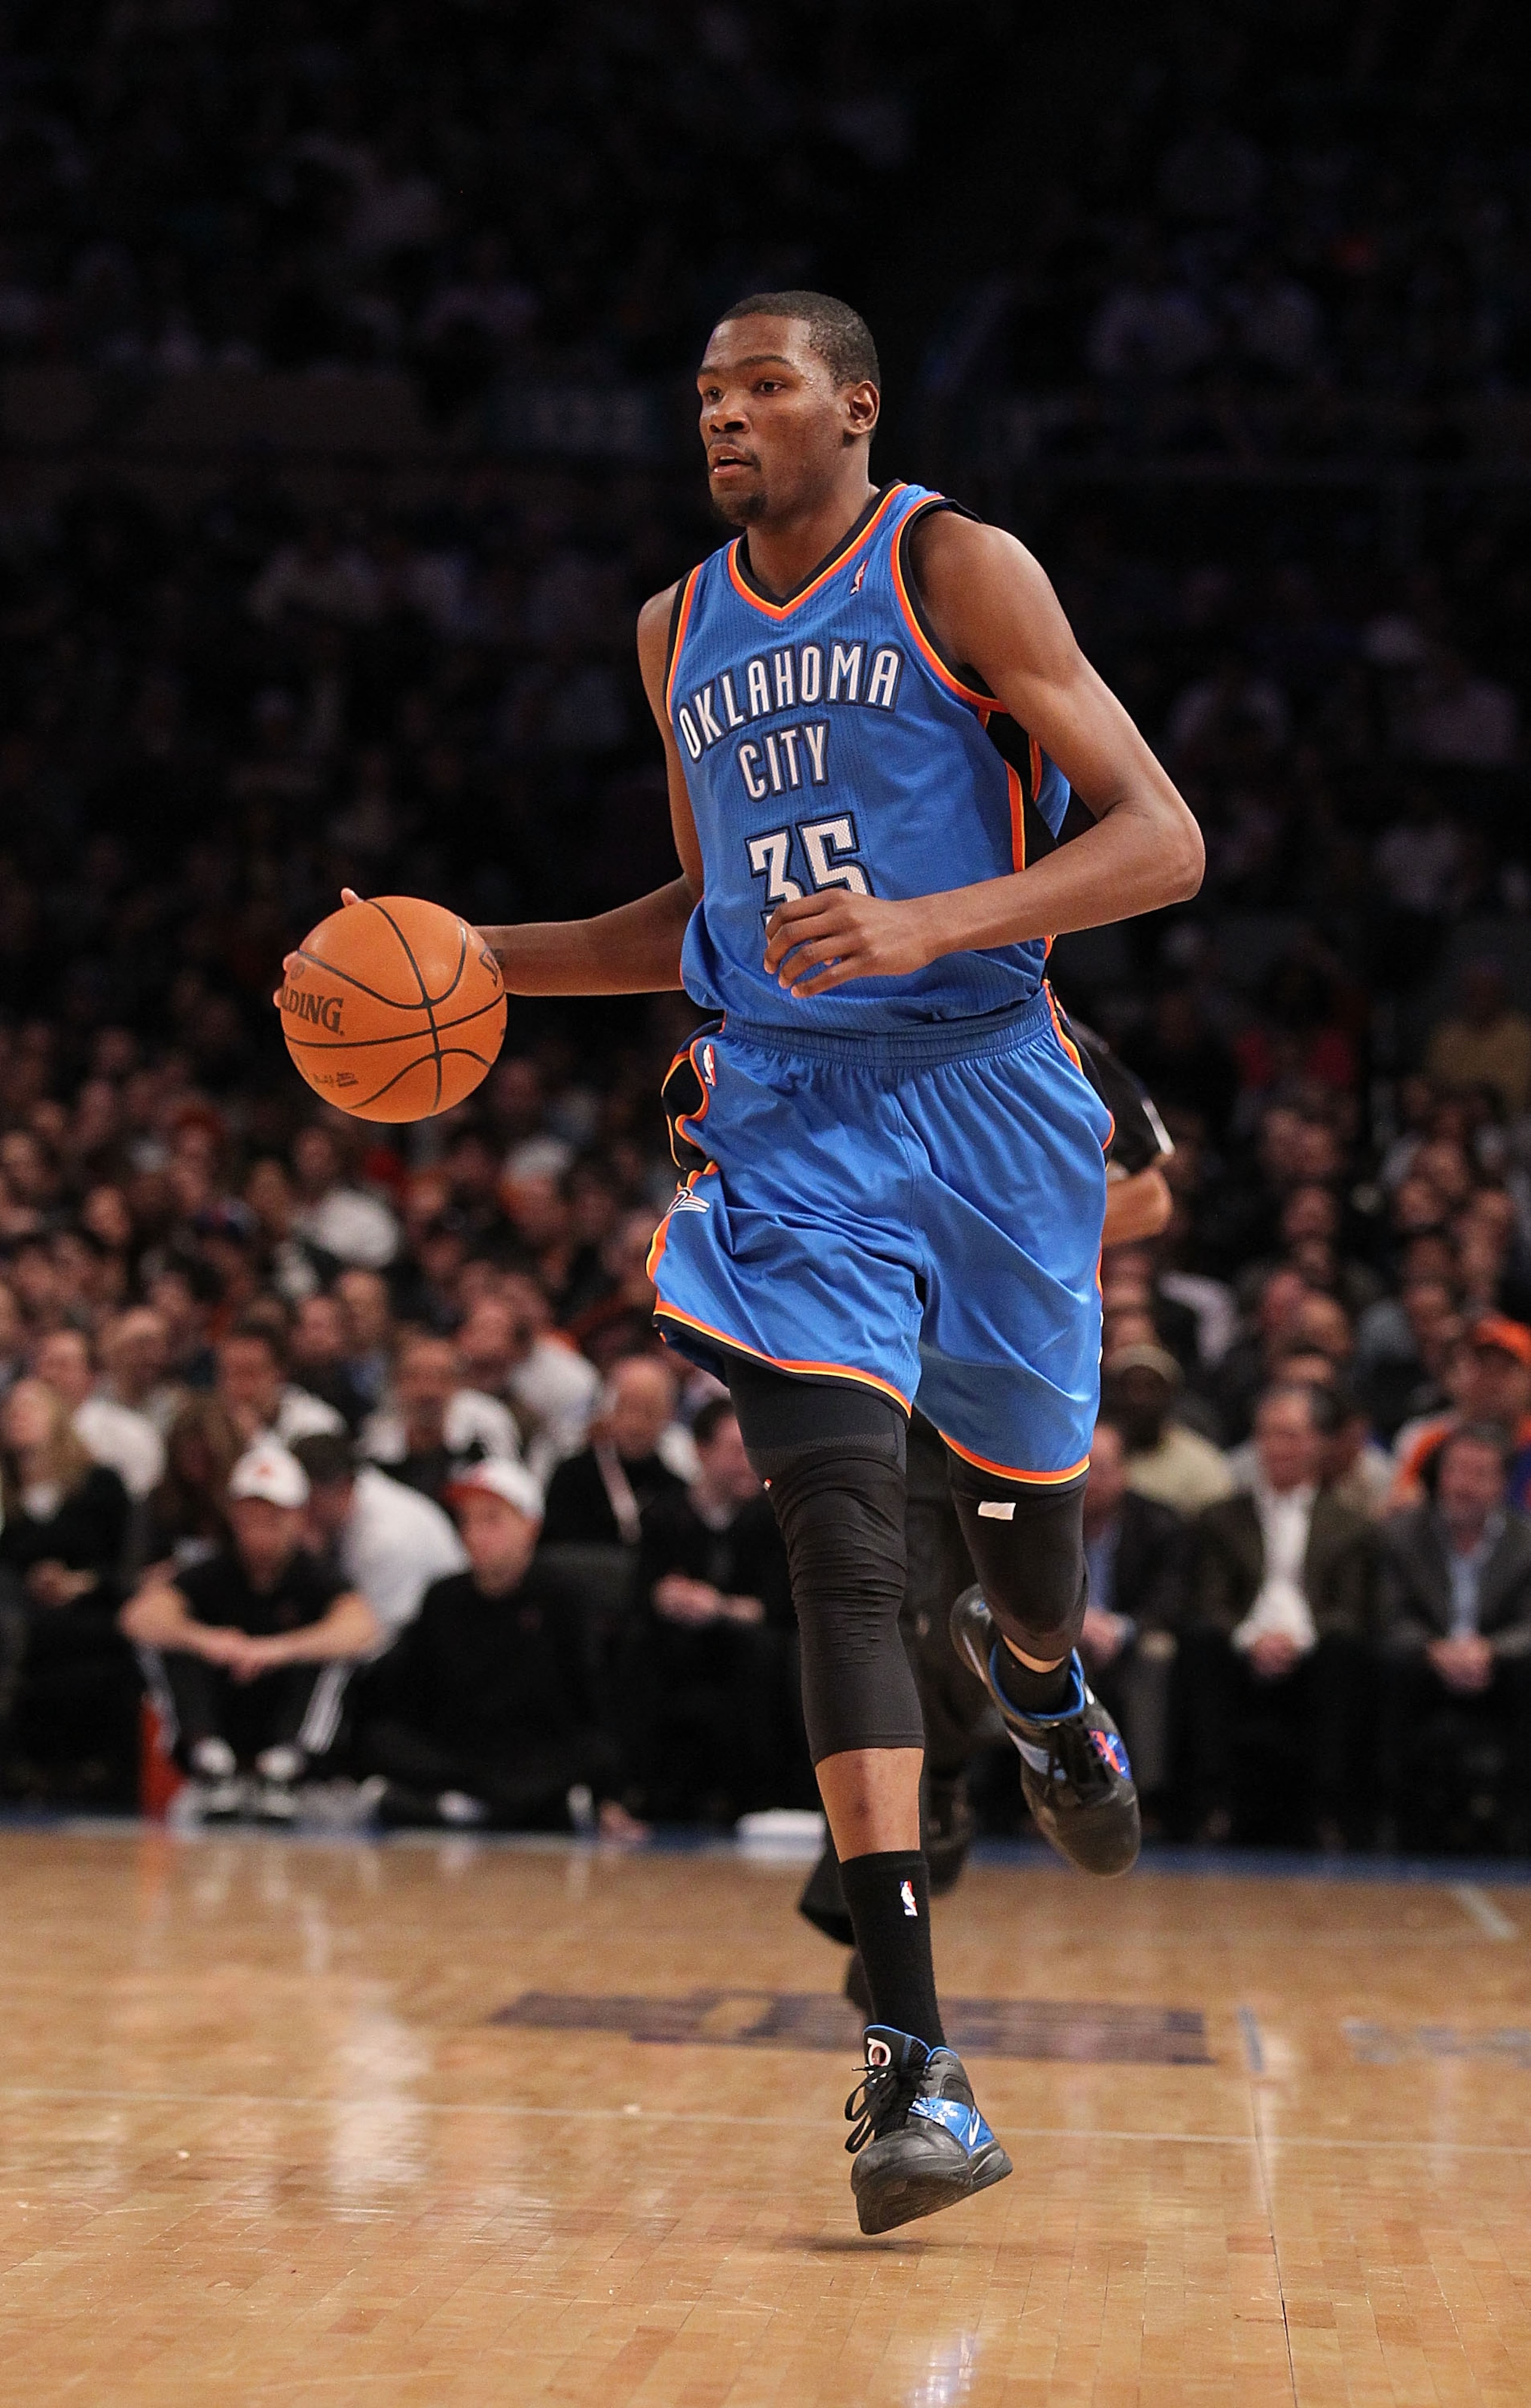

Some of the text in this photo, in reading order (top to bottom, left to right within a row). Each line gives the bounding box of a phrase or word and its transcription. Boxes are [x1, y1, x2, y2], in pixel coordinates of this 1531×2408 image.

[678, 640, 902, 762] OKLAHOMA
[737, 721, 828, 801] CITY
[745, 812, 874, 926] 35
